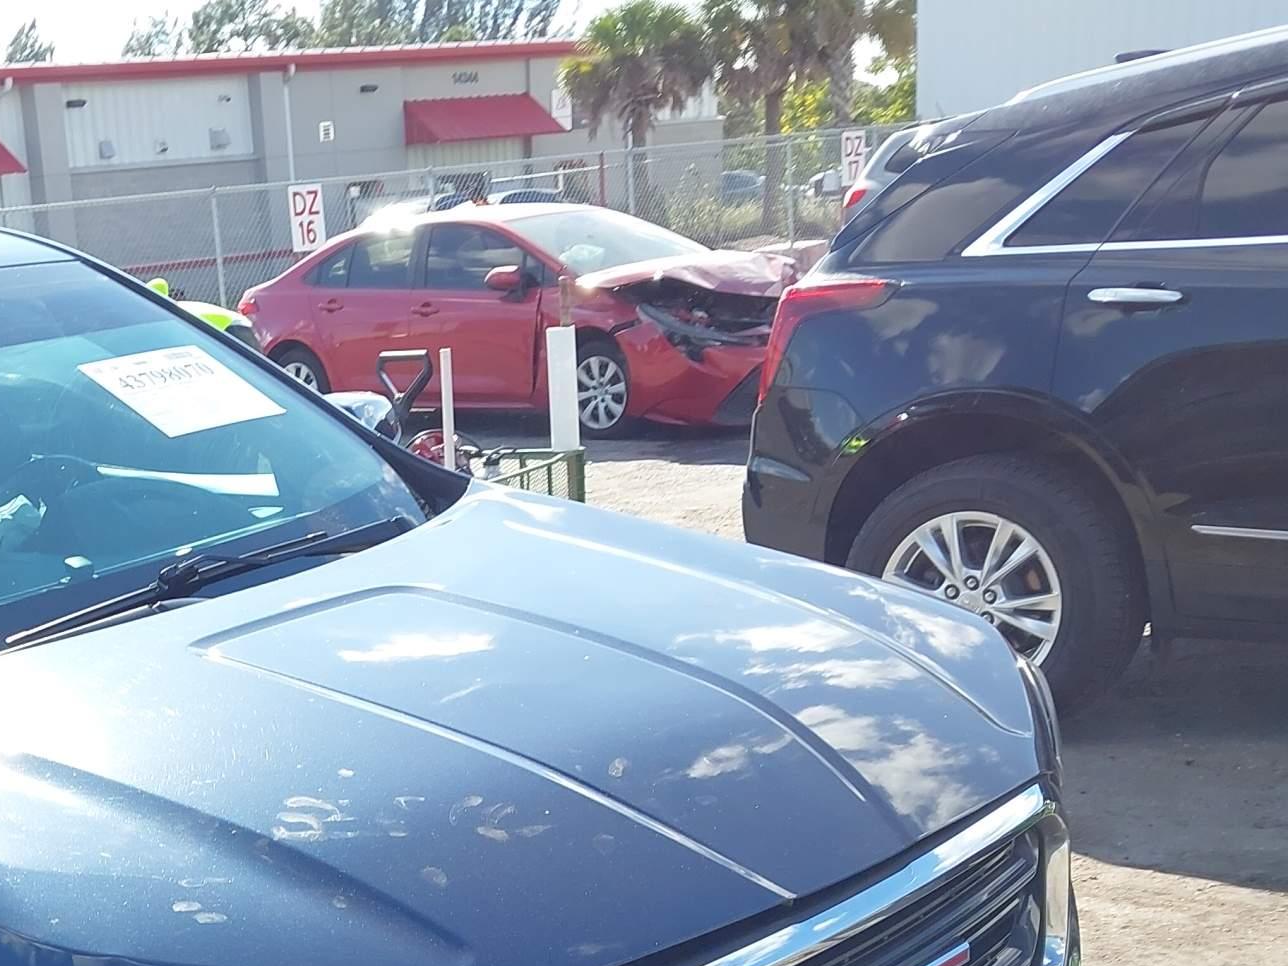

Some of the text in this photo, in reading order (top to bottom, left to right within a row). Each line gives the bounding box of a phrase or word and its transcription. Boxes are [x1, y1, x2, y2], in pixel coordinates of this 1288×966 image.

[844, 136, 863, 157] DZ
[848, 160, 859, 180] 17
[292, 190, 320, 216] DZ
[298, 220, 317, 246] 16
[118, 361, 215, 390] 43798070
